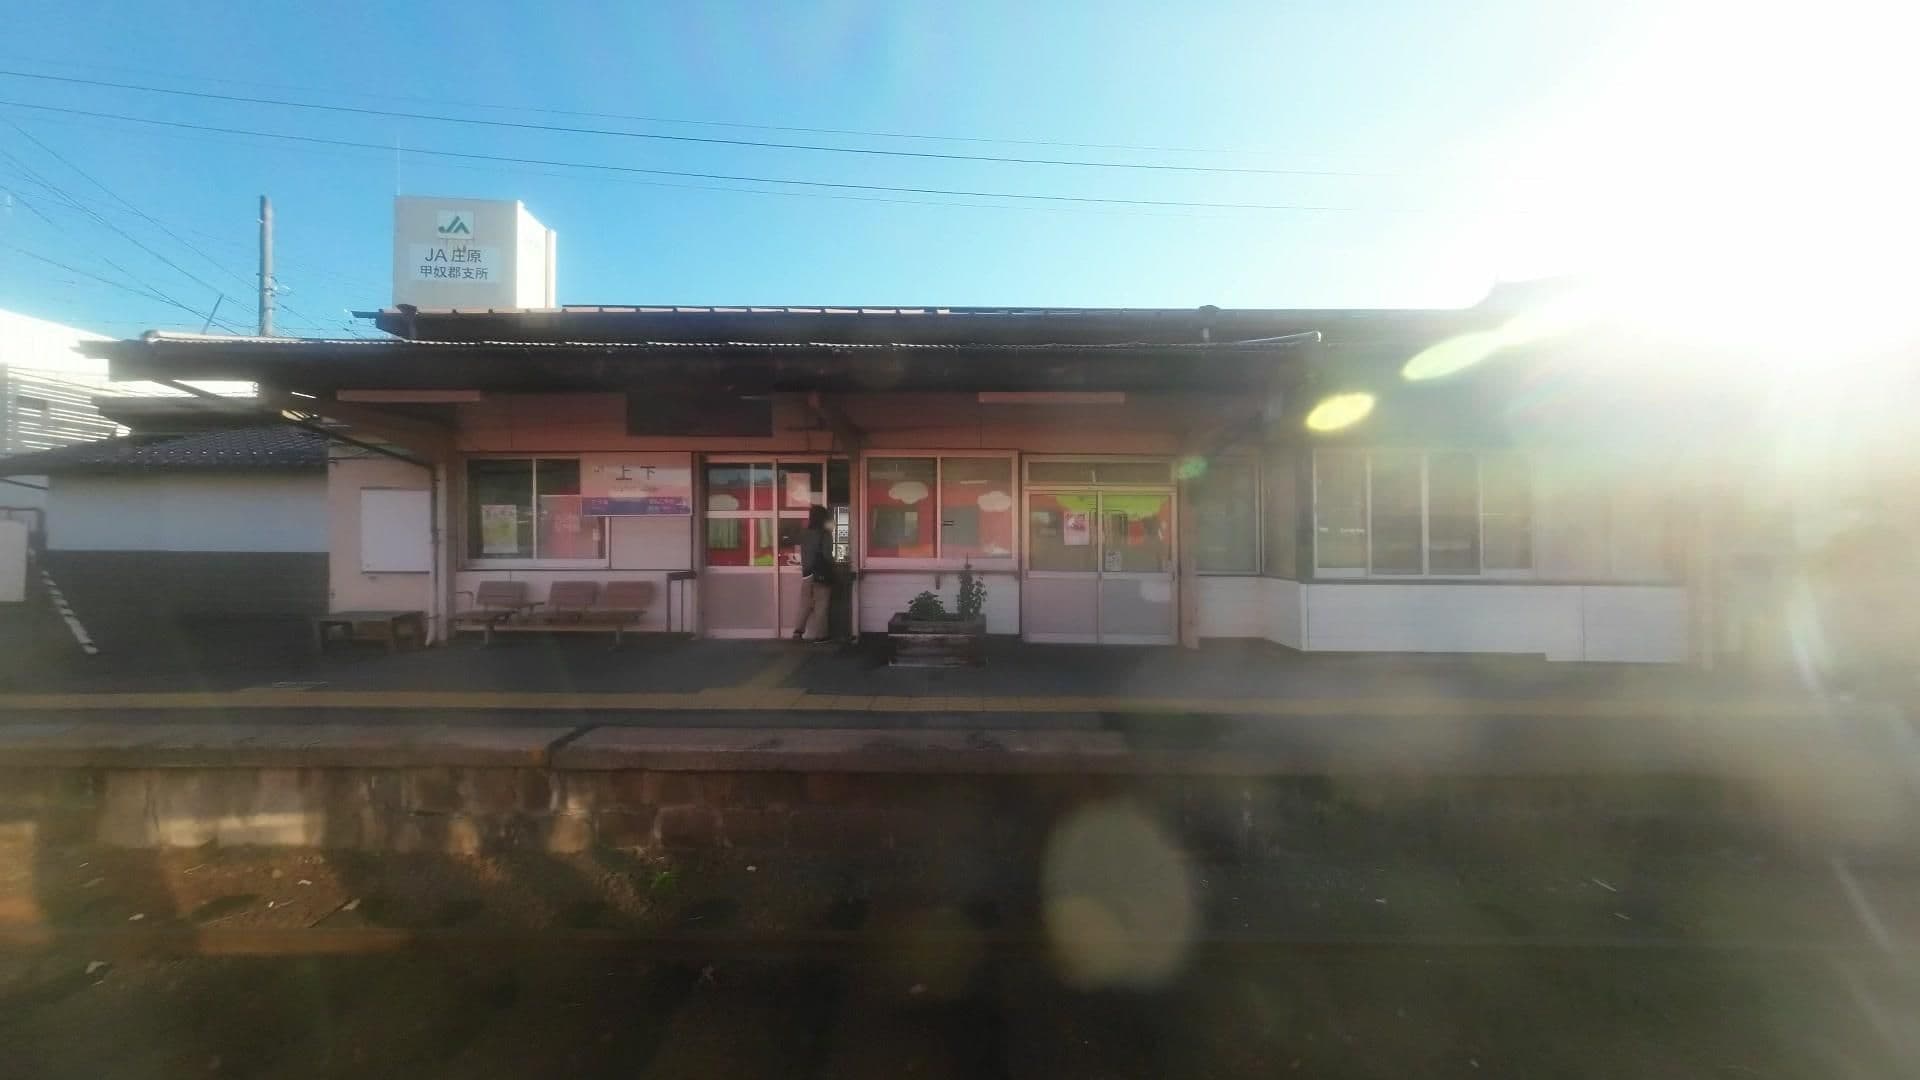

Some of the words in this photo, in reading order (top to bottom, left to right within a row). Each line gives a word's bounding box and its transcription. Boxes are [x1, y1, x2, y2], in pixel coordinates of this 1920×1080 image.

[438, 216, 470, 234] JA
[420, 265, 488, 280] 甲奴郡支所
